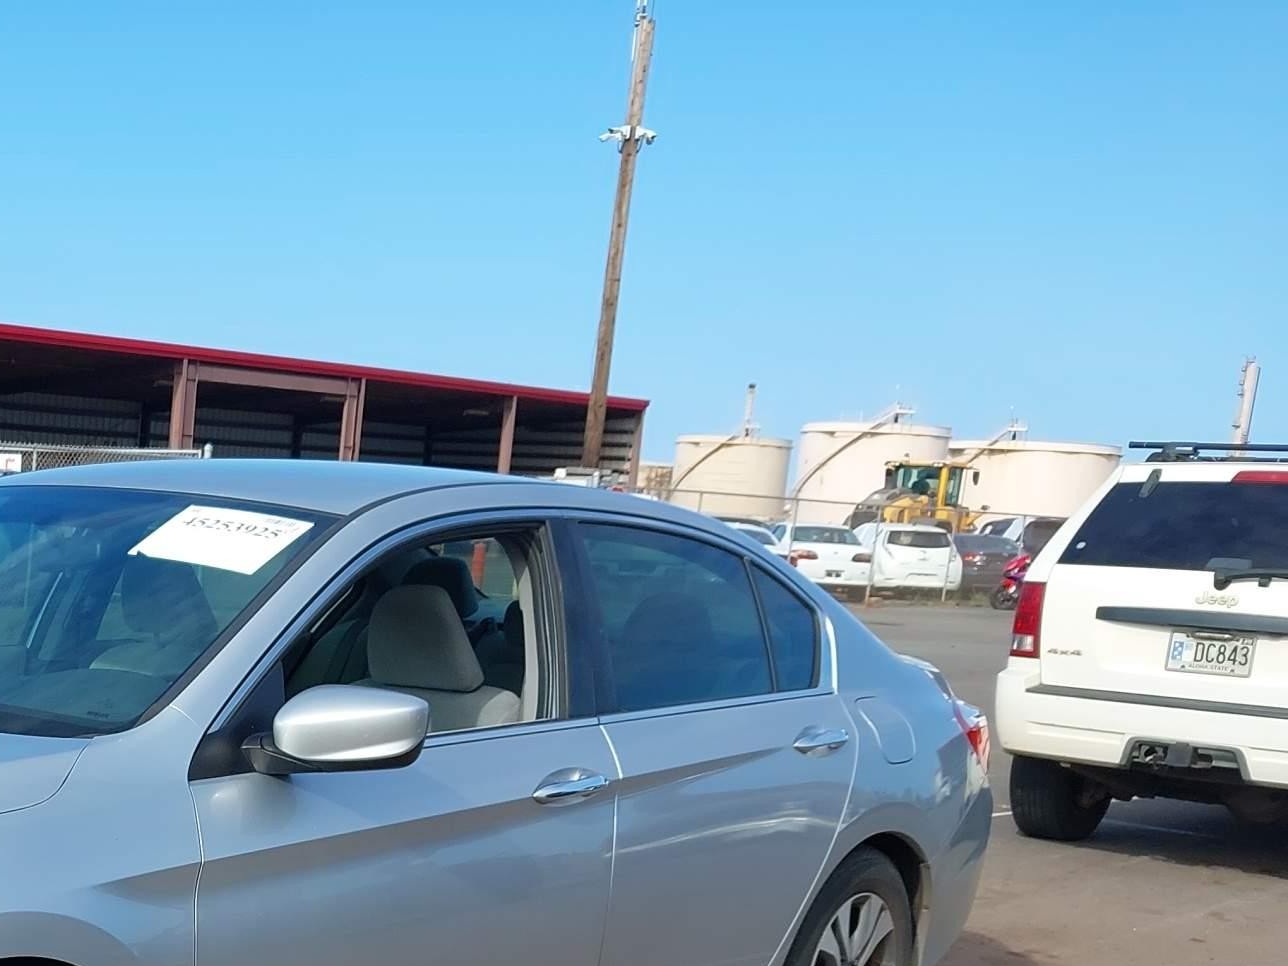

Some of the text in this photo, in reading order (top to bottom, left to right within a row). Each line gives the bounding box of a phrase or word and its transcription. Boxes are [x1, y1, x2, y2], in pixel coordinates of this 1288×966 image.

[183, 516, 283, 539] 45253925
[1194, 591, 1240, 609] Jeep
[1193, 641, 1250, 667] DC843
